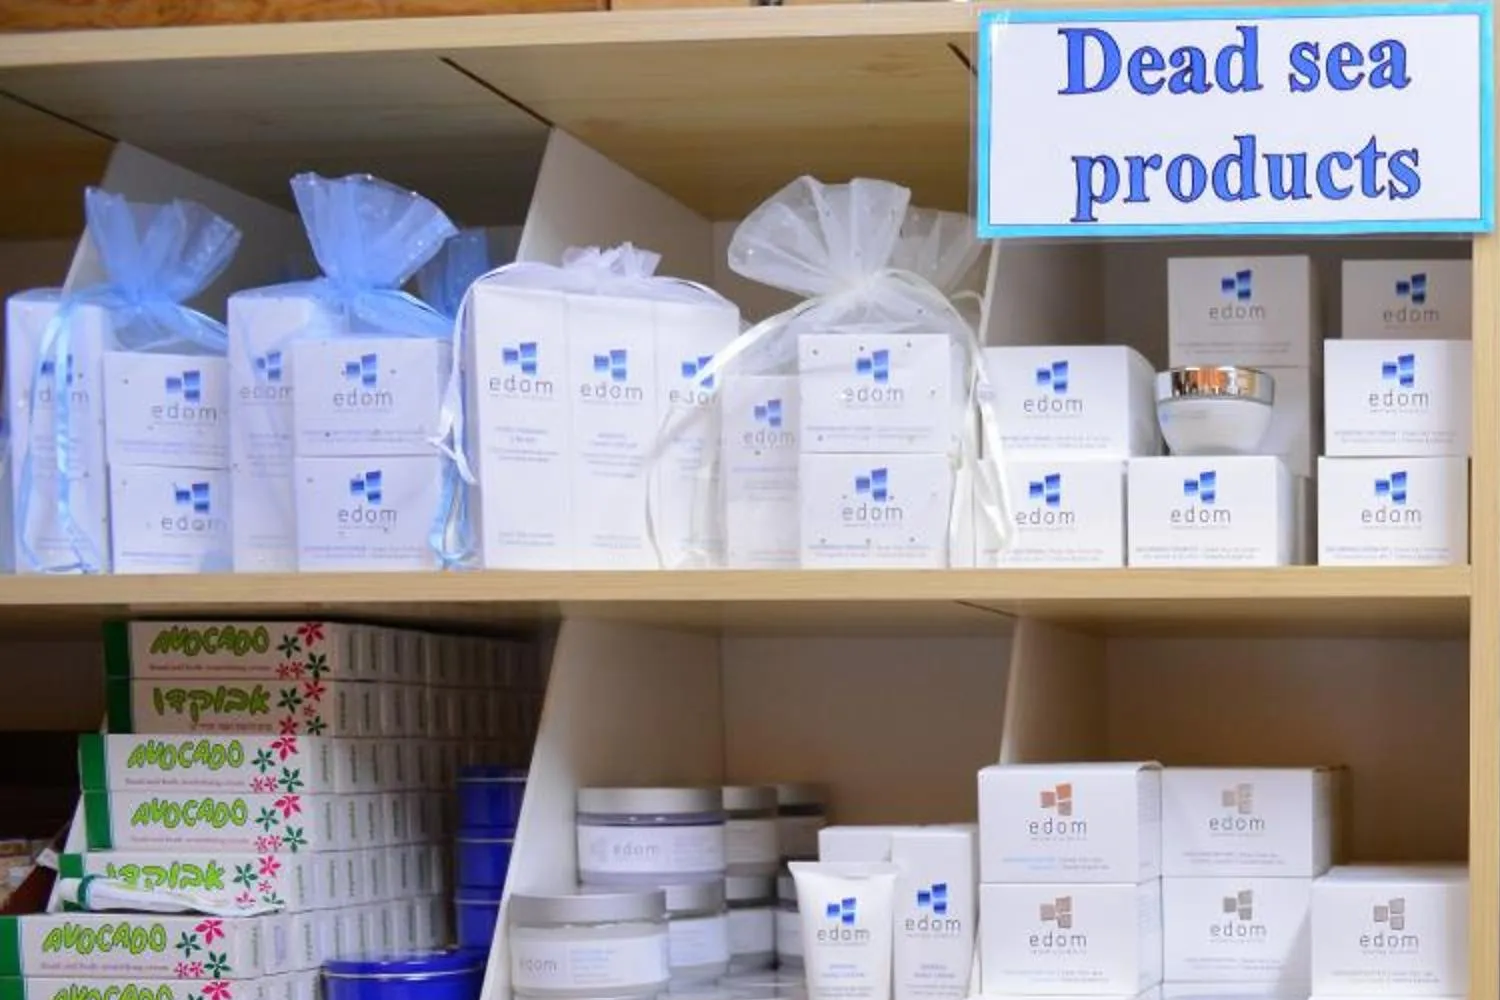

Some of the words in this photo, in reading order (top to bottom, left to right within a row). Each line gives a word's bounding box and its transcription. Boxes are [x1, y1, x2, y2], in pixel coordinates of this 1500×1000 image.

[1057, 25, 1263, 95] Dead
[1289, 38, 1411, 94] sea
[1070, 134, 1421, 223] products
[1208, 302, 1265, 319] edom
[1382, 306, 1440, 323] edom
[489, 375, 553, 394] edom
[580, 382, 643, 401] edom
[843, 386, 904, 401] edom
[333, 390, 393, 407] edom
[1023, 397, 1083, 414] edom
[1368, 390, 1429, 407] edom
[152, 403, 217, 421] edom
[743, 430, 795, 446] edom
[338, 507, 397, 523] edom
[842, 503, 903, 521] edom
[1016, 508, 1075, 525] edom
[1170, 506, 1231, 524] edom
[1361, 506, 1422, 524] edom
[150, 625, 270, 656] AVOCADO
[153, 684, 271, 726] אבוקדו
[127, 739, 245, 770] AVOCADO
[130, 797, 248, 829] AVOCADO
[1028, 817, 1087, 836] edom
[1209, 815, 1265, 832] edom
[905, 915, 961, 932] edom
[1210, 921, 1267, 938] edom
[42, 921, 167, 954] AVOCADO
[817, 925, 870, 942] edom
[1029, 931, 1087, 949] edom
[1359, 931, 1420, 949] edom
